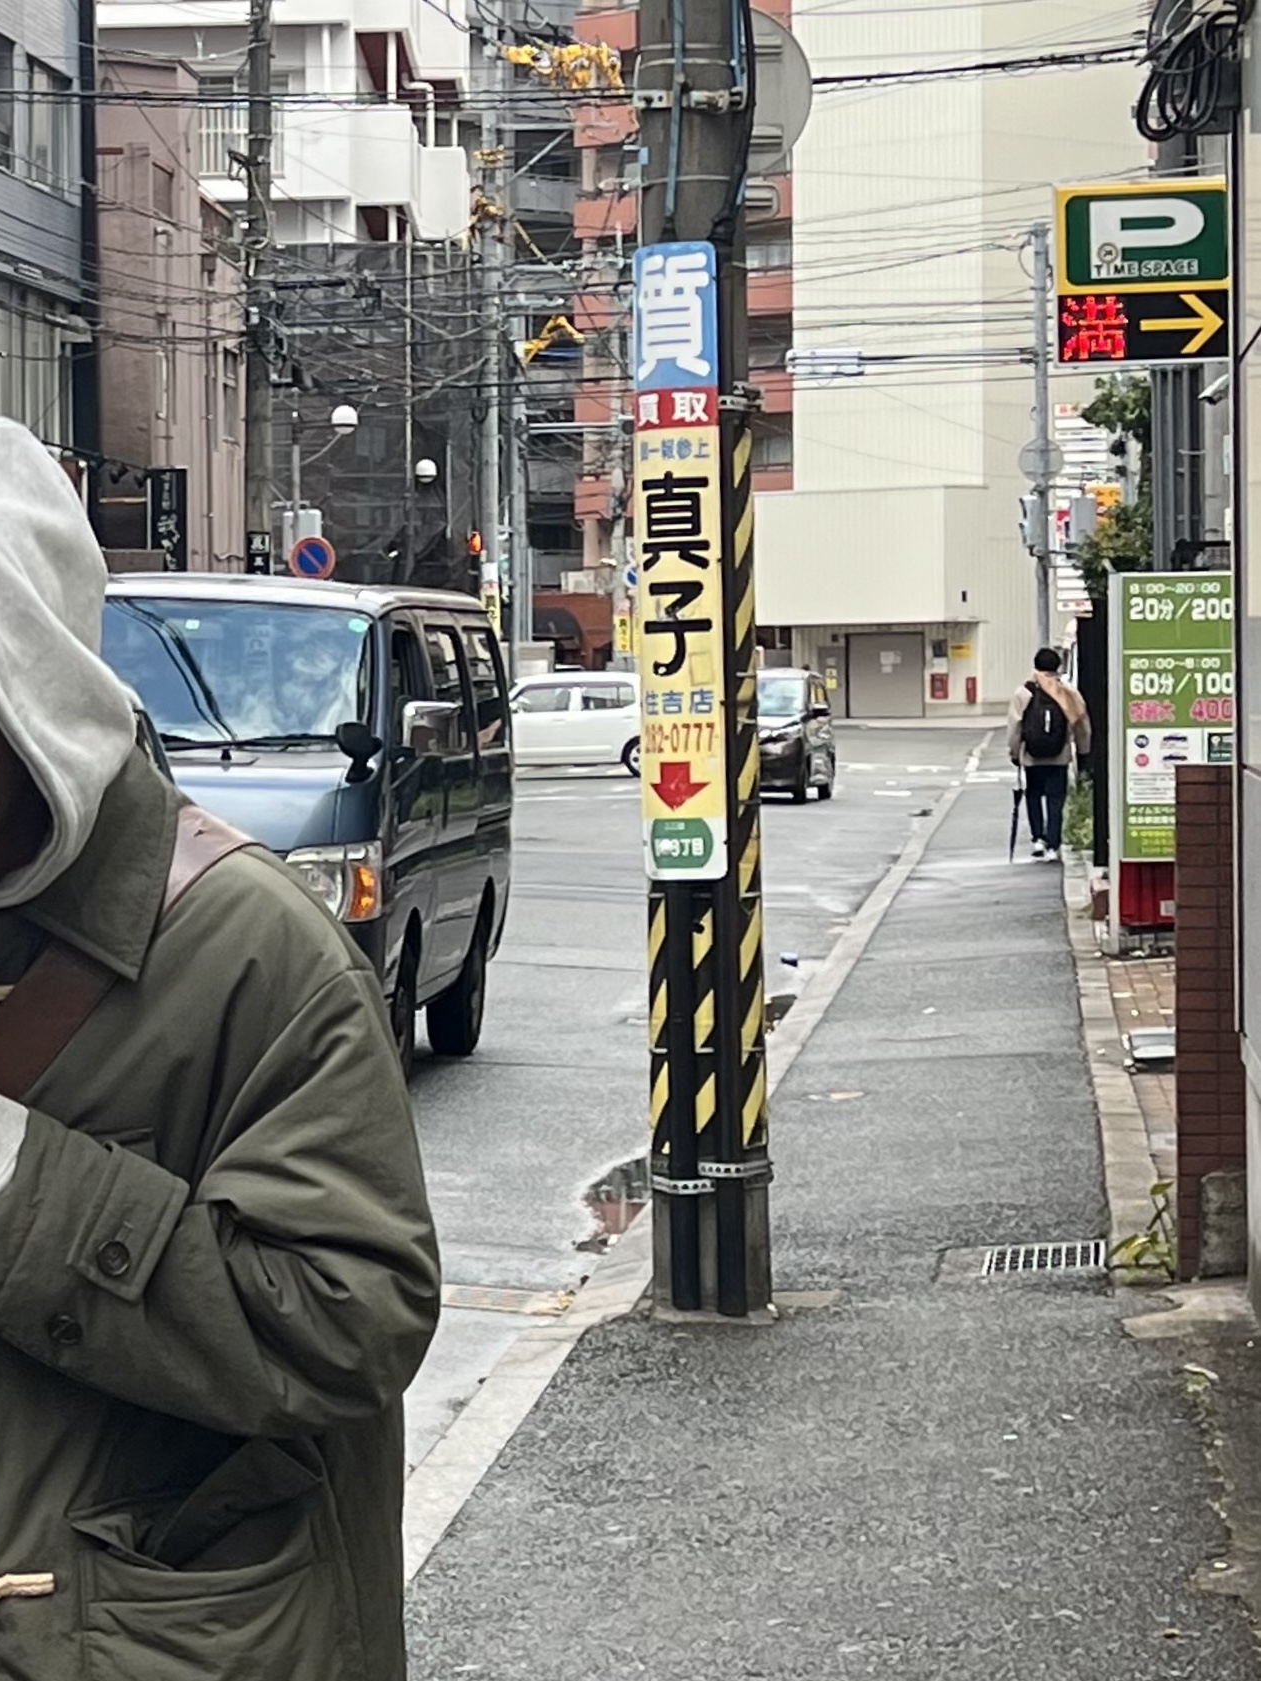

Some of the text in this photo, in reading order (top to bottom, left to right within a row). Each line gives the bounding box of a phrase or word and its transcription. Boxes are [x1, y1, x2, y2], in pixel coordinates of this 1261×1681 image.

[1094, 259, 1199, 277] TIME SPACE
[638, 253, 711, 381] 質
[1061, 296, 1129, 361] 満
[637, 391, 709, 428] 買取
[641, 470, 713, 678] 真子
